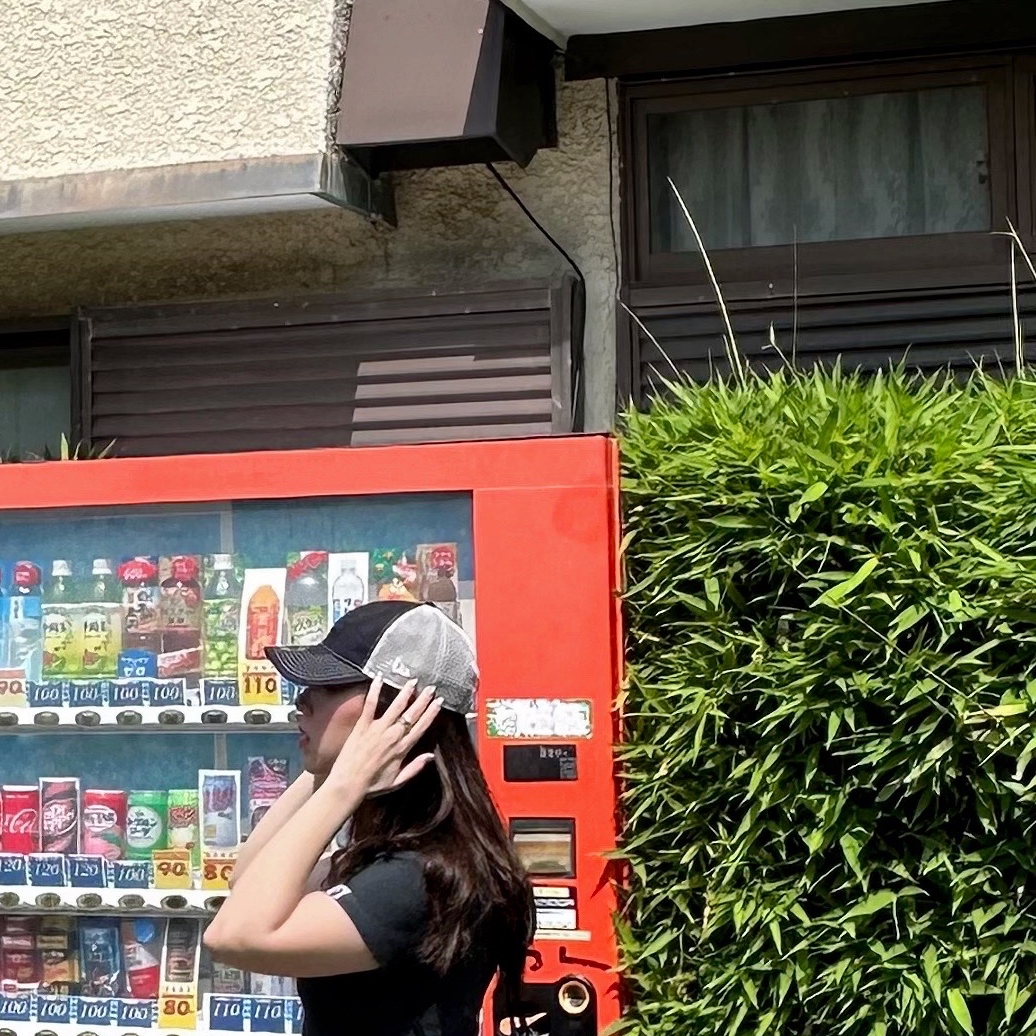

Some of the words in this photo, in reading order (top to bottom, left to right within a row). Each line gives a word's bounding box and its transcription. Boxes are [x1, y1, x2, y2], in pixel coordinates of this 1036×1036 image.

[34, 684, 60, 701] 100
[74, 684, 100, 701] 100
[114, 684, 140, 701] 100
[154, 684, 180, 701] 100
[208, 684, 236, 700] 100
[244, 676, 277, 694] 110
[35, 862, 60, 876] 120
[74, 863, 98, 877] 120
[118, 864, 146, 882] 100
[158, 861, 187, 876] 90
[0, 1000, 27, 1015] 100
[41, 1002, 67, 1017] 100
[81, 1004, 107, 1019] 100
[121, 1005, 148, 1020] 100
[163, 999, 191, 1016] 80
[214, 1003, 241, 1017] 110
[254, 1005, 282, 1019] 110
